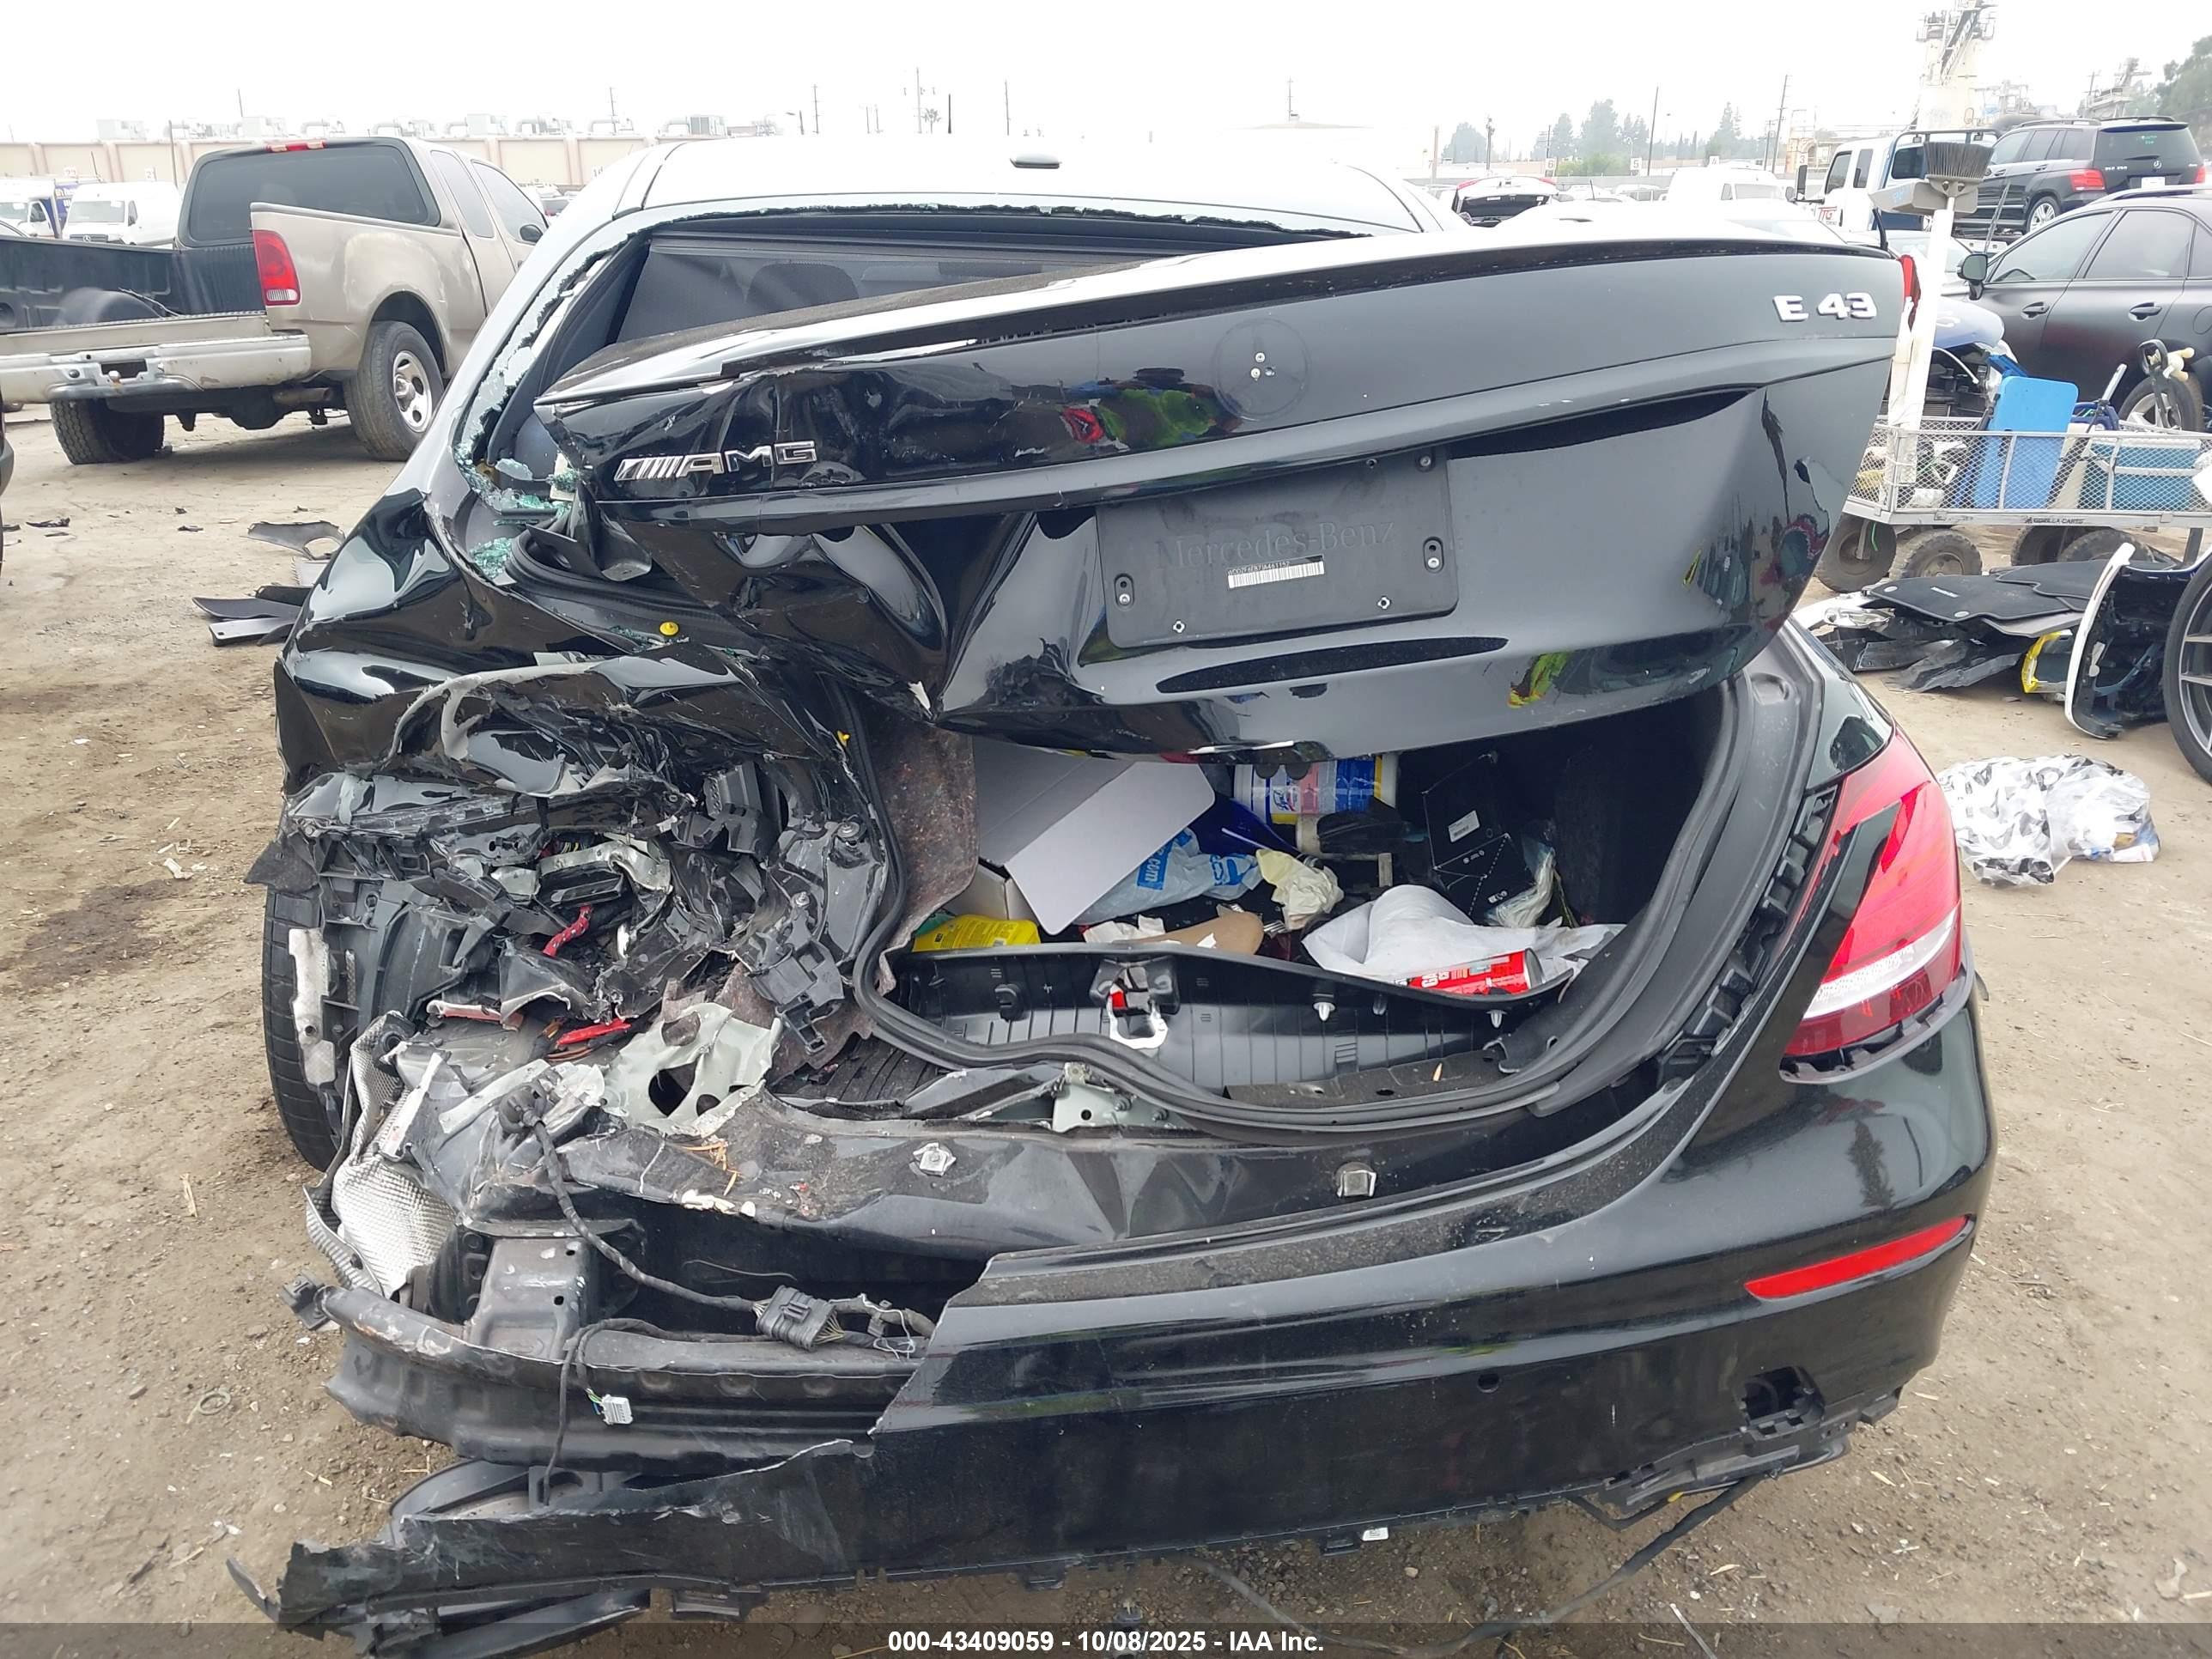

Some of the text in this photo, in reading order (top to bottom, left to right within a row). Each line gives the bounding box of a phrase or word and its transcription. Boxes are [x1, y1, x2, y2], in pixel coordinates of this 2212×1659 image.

[1772, 292, 1878, 323] E 43
[674, 440, 817, 478] AMG
[1155, 521, 1396, 570] Mercedes-Benz
